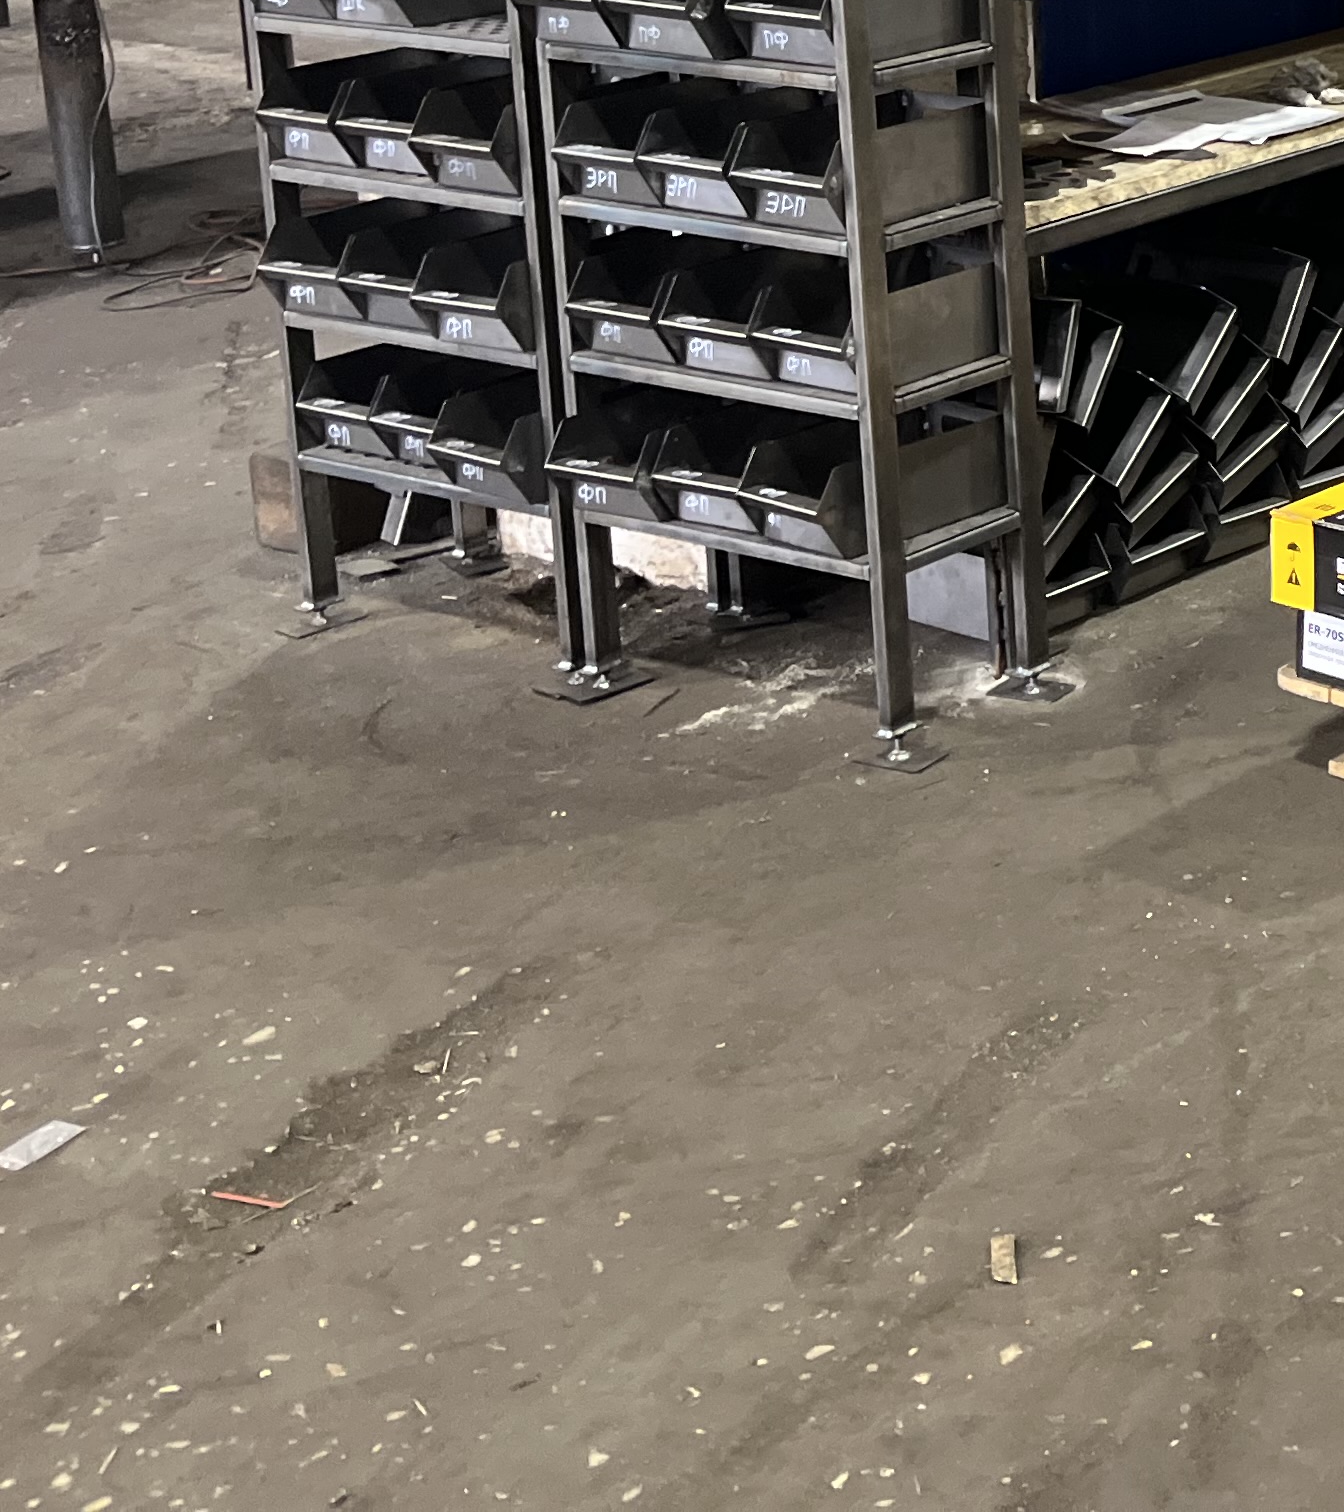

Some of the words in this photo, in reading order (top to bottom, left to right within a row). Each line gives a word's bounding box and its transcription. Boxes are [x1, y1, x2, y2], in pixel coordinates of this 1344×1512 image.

[763, 29, 789, 50] ПФ
[288, 129, 309, 150] ФП
[372, 138, 396, 157] ФП
[586, 167, 618, 194] ЭРП
[666, 174, 698, 198] ЭРП
[765, 191, 806, 217] ЭРП
[289, 284, 316, 306] ФП
[446, 316, 473, 339] ФП
[689, 336, 715, 361] ФП
[577, 483, 607, 504] ФП
[685, 494, 710, 516] ФП
